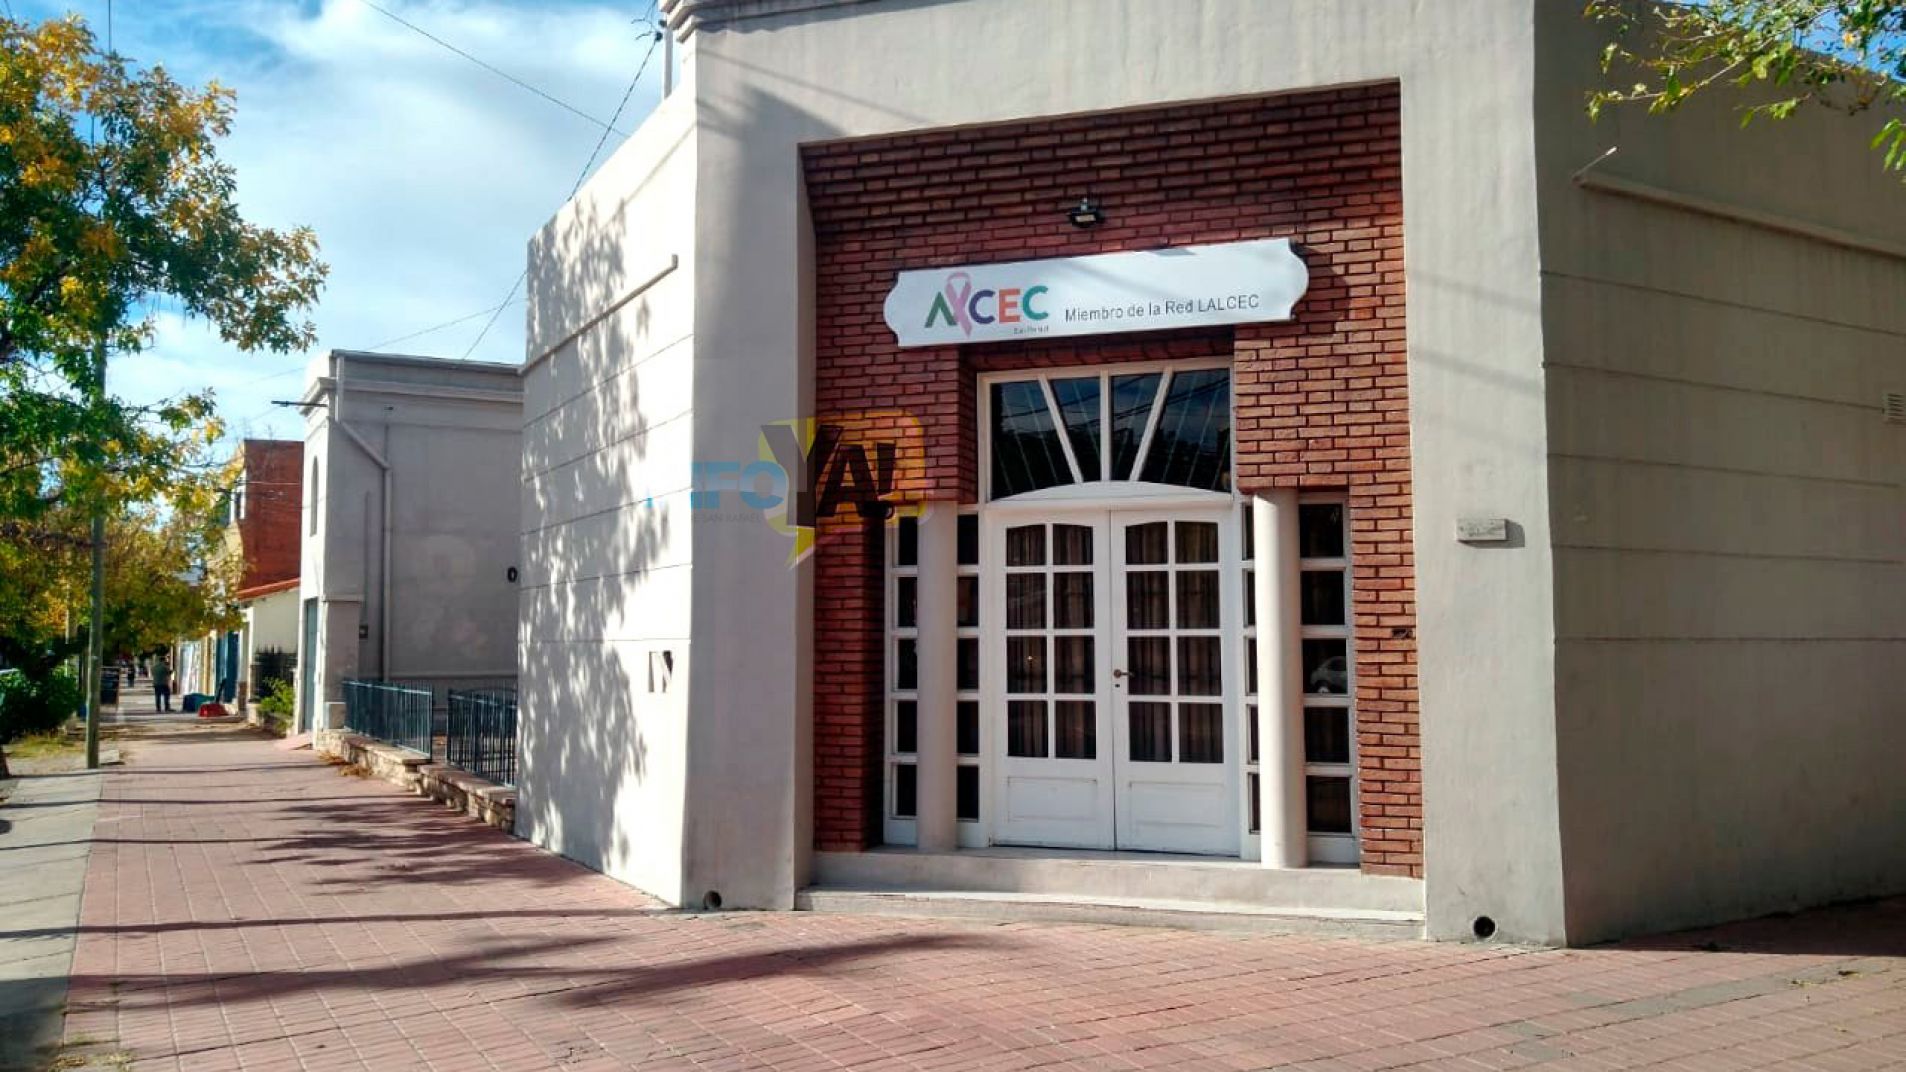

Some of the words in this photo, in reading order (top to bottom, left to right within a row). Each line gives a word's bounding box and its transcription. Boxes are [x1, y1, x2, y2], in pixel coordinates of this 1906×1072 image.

[1065, 306, 1123, 323] Miembro
[1127, 304, 1144, 317] de
[1149, 301, 1161, 316] la
[1165, 299, 1194, 315] Red
[1198, 294, 1260, 313] LALCEC
